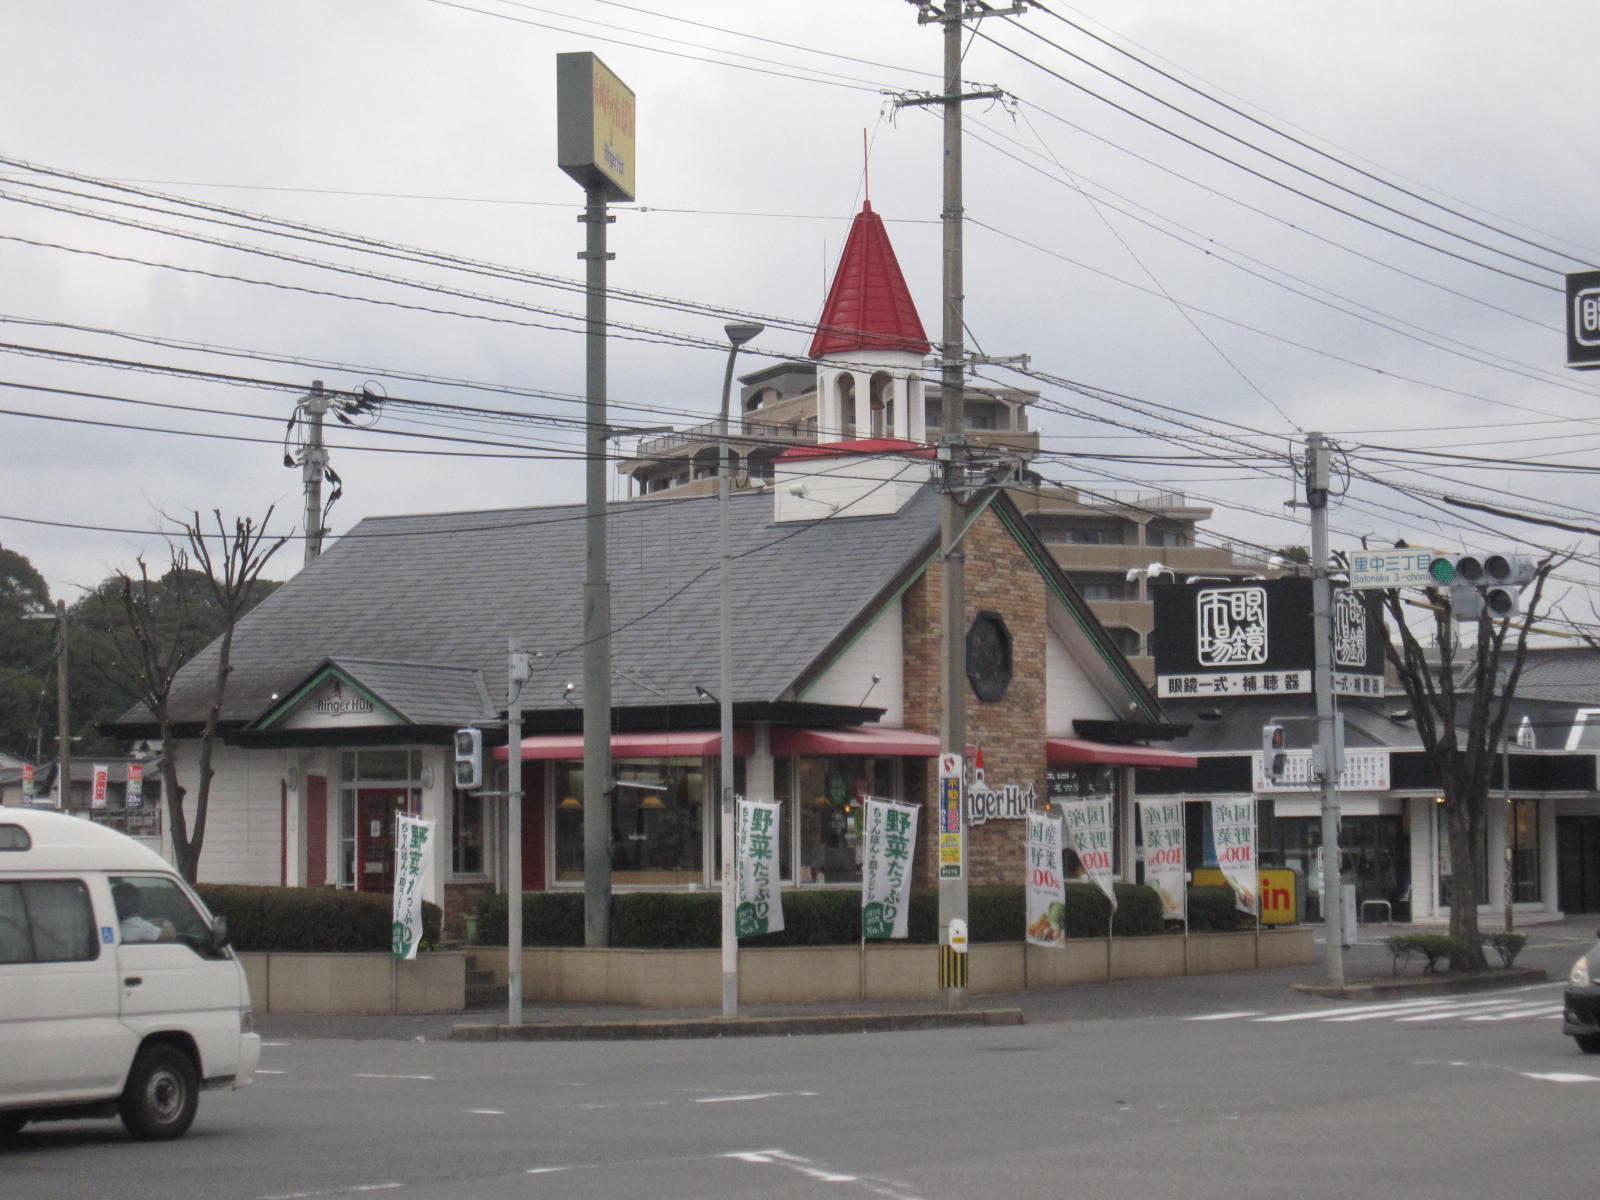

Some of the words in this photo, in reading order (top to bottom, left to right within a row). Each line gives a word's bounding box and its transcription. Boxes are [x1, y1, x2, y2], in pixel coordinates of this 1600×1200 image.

[1354, 554, 1431, 572] 里中三丁目
[1354, 574, 1390, 584] Satonaka
[968, 791, 1004, 822] nger
[884, 809, 912, 923] 野菜たっぷり
